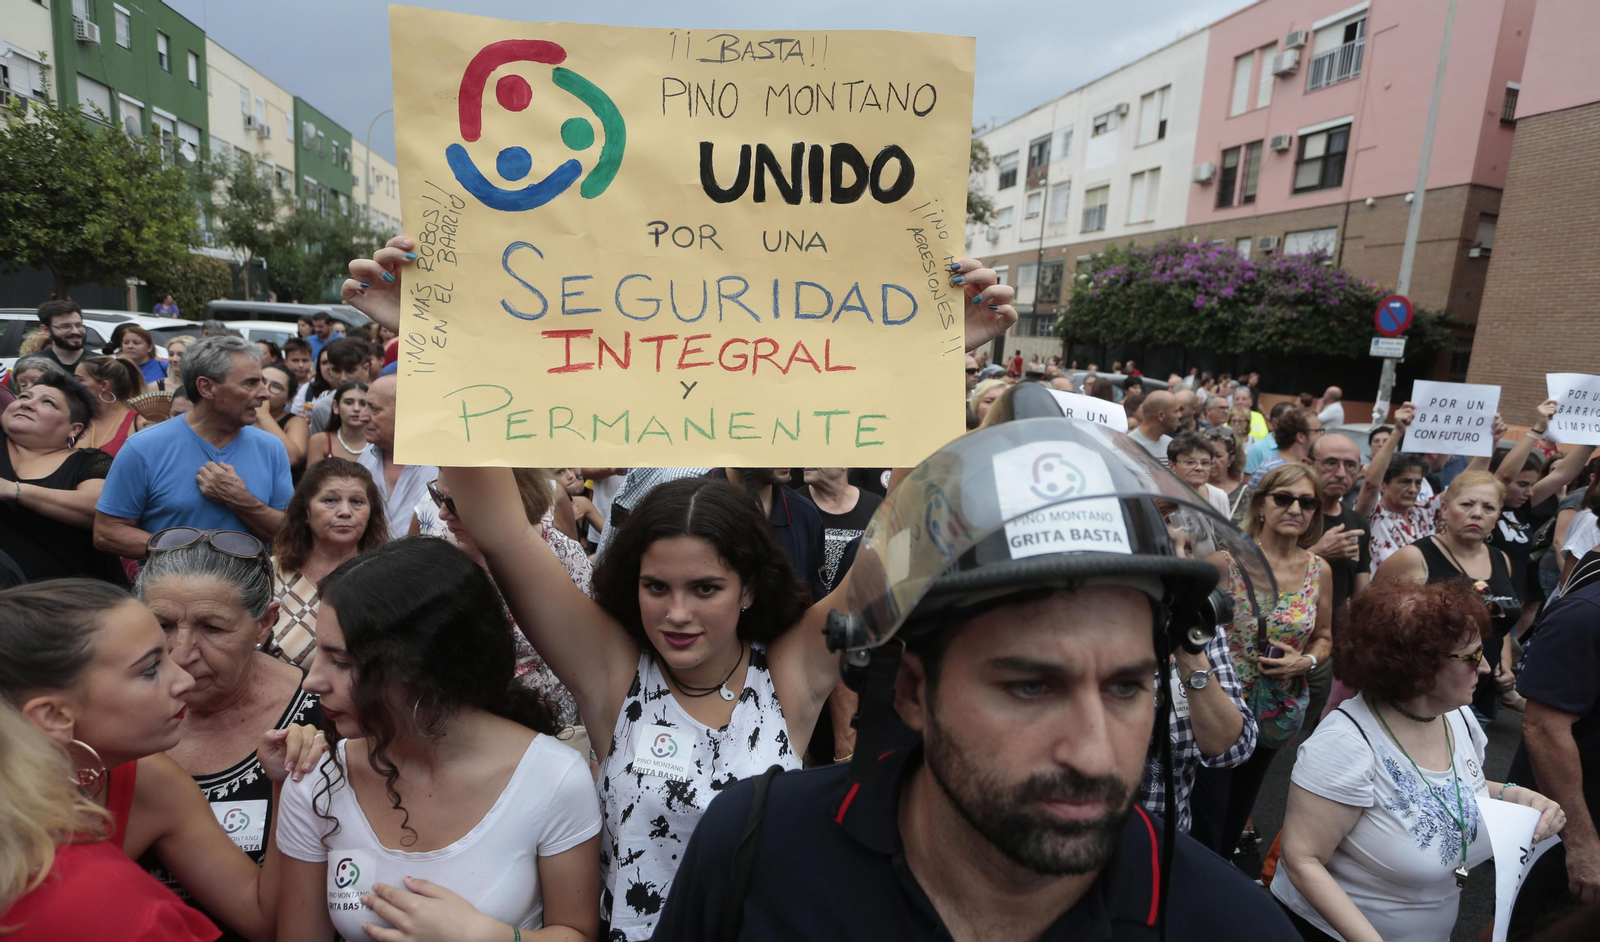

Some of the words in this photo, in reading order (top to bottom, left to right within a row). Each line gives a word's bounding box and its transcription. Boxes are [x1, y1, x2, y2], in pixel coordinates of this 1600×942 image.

[661, 77, 739, 119] PINO
[764, 79, 938, 119] MONTANO
[699, 140, 916, 206] UNIDO
[437, 194, 466, 267] BARRIO
[646, 220, 724, 252] POR
[762, 230, 828, 253] UNA
[500, 240, 919, 326] SEGURIDAD
[434, 281, 455, 304] EL
[431, 319, 449, 349] EN
[540, 328, 857, 376] INTEGRAL
[679, 380, 698, 400] Y
[1567, 389, 1588, 400] POR
[1592, 392, 1600, 402] U
[1429, 397, 1457, 409] POR
[1466, 400, 1485, 410] UN
[443, 384, 890, 448] PERMANENTE
[1086, 411, 1108, 424] UN
[1419, 413, 1485, 427] BARRIO
[1414, 429, 1437, 440] CON
[1438, 431, 1480, 442] FUTURO
[1557, 420, 1600, 433] LIMPIO
[1049, 511, 1114, 523] MONTANO
[1010, 529, 1065, 549] GRITA
[1070, 528, 1124, 544] BASTA
[636, 757, 652, 765] PINO
[652, 759, 684, 772] MONTANO
[631, 765, 657, 776] GRITA
[657, 770, 685, 783] BASTA
[230, 834, 259, 842] ONTANO
[238, 843, 260, 851] ASTA
[328, 901, 341, 911] RITA
